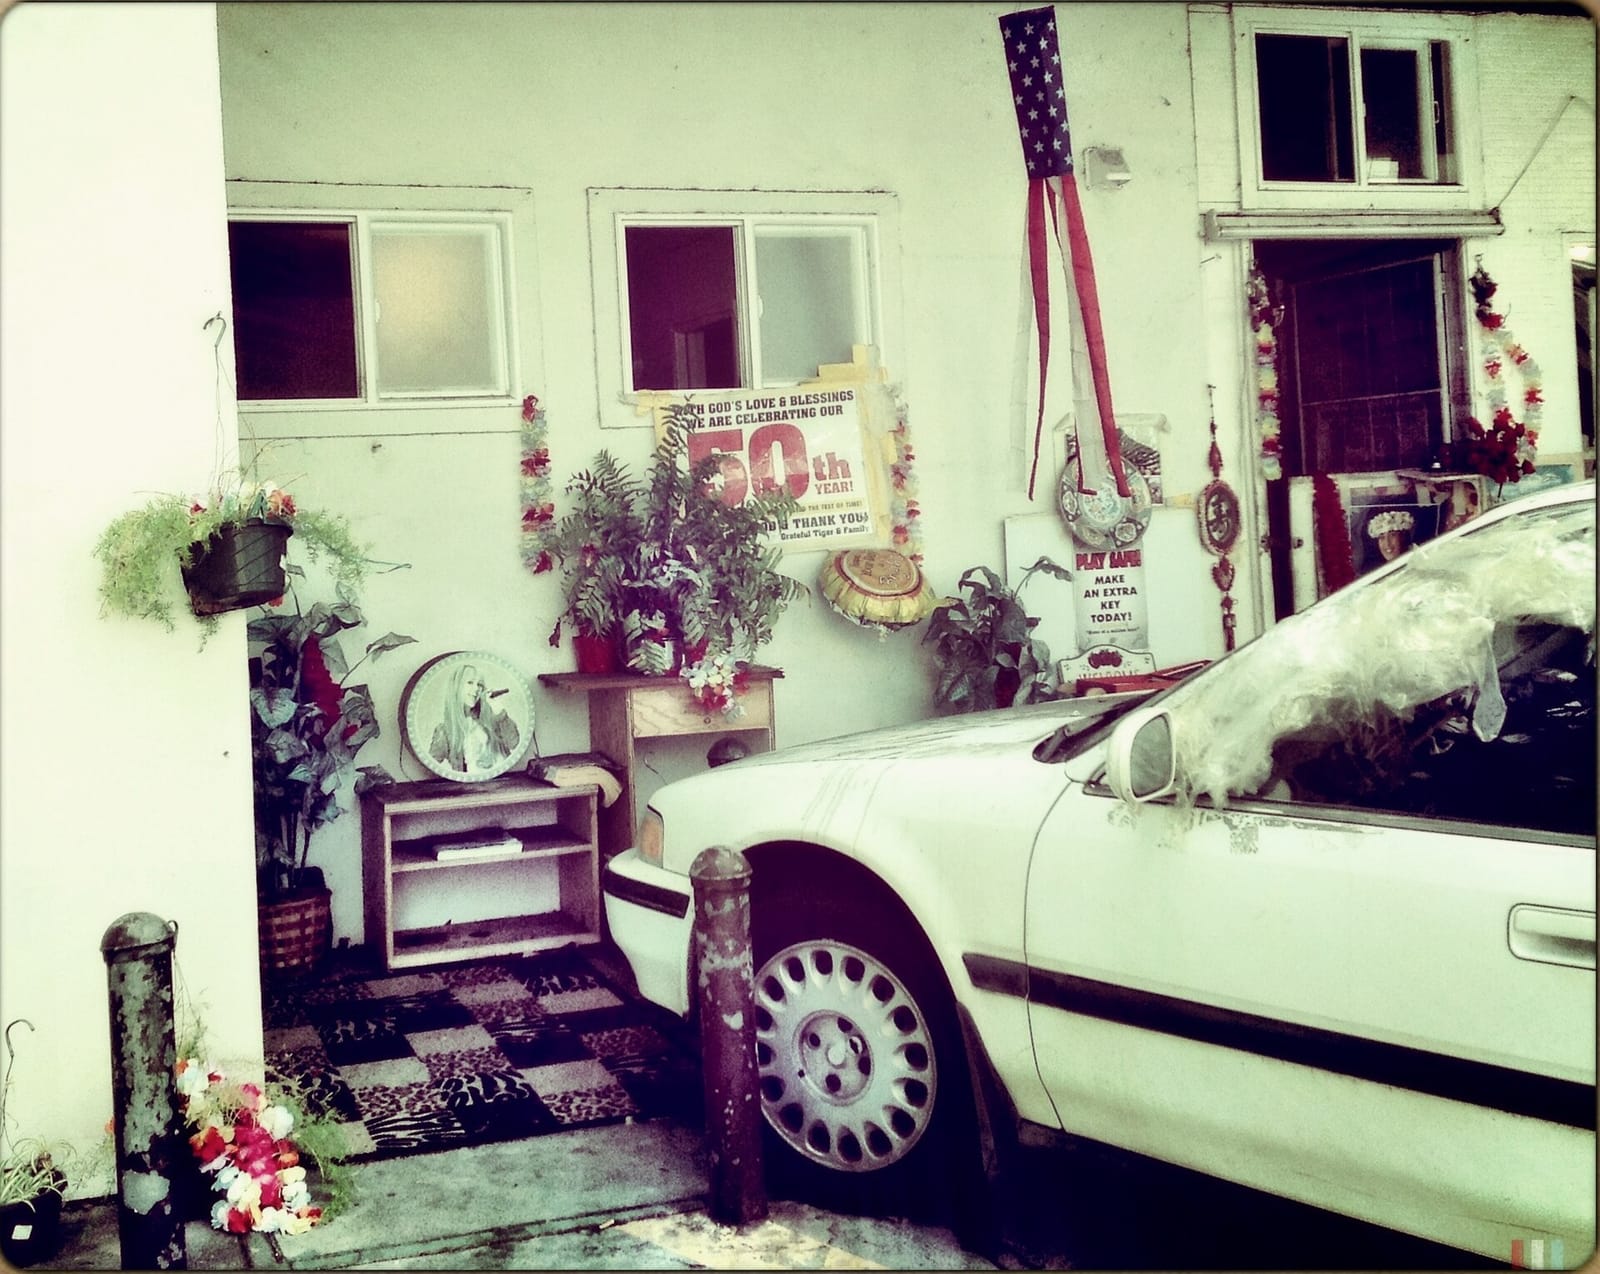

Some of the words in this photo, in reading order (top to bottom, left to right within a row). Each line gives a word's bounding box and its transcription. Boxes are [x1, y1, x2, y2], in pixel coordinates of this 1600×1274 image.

[708, 400, 743, 415] GOD'S
[746, 398, 776, 411] LOVE
[779, 397, 787, 407] &
[790, 390, 854, 406] BLESSINGS
[709, 416, 732, 427] ARE
[736, 407, 817, 424] CELEBRATING
[820, 405, 844, 417] OUR
[815, 481, 854, 495] YEAR!
[793, 514, 836, 529] THANK
[781, 531, 811, 540] Grateful
[813, 529, 834, 538] Tiger
[1076, 552, 1107, 571] PLAY
[1095, 575, 1125, 585] MAKE
[1084, 589, 1099, 598] AN
[1103, 587, 1138, 597] EXTRA
[1101, 601, 1120, 610] KEY
[1091, 612, 1132, 623] TODAY!
